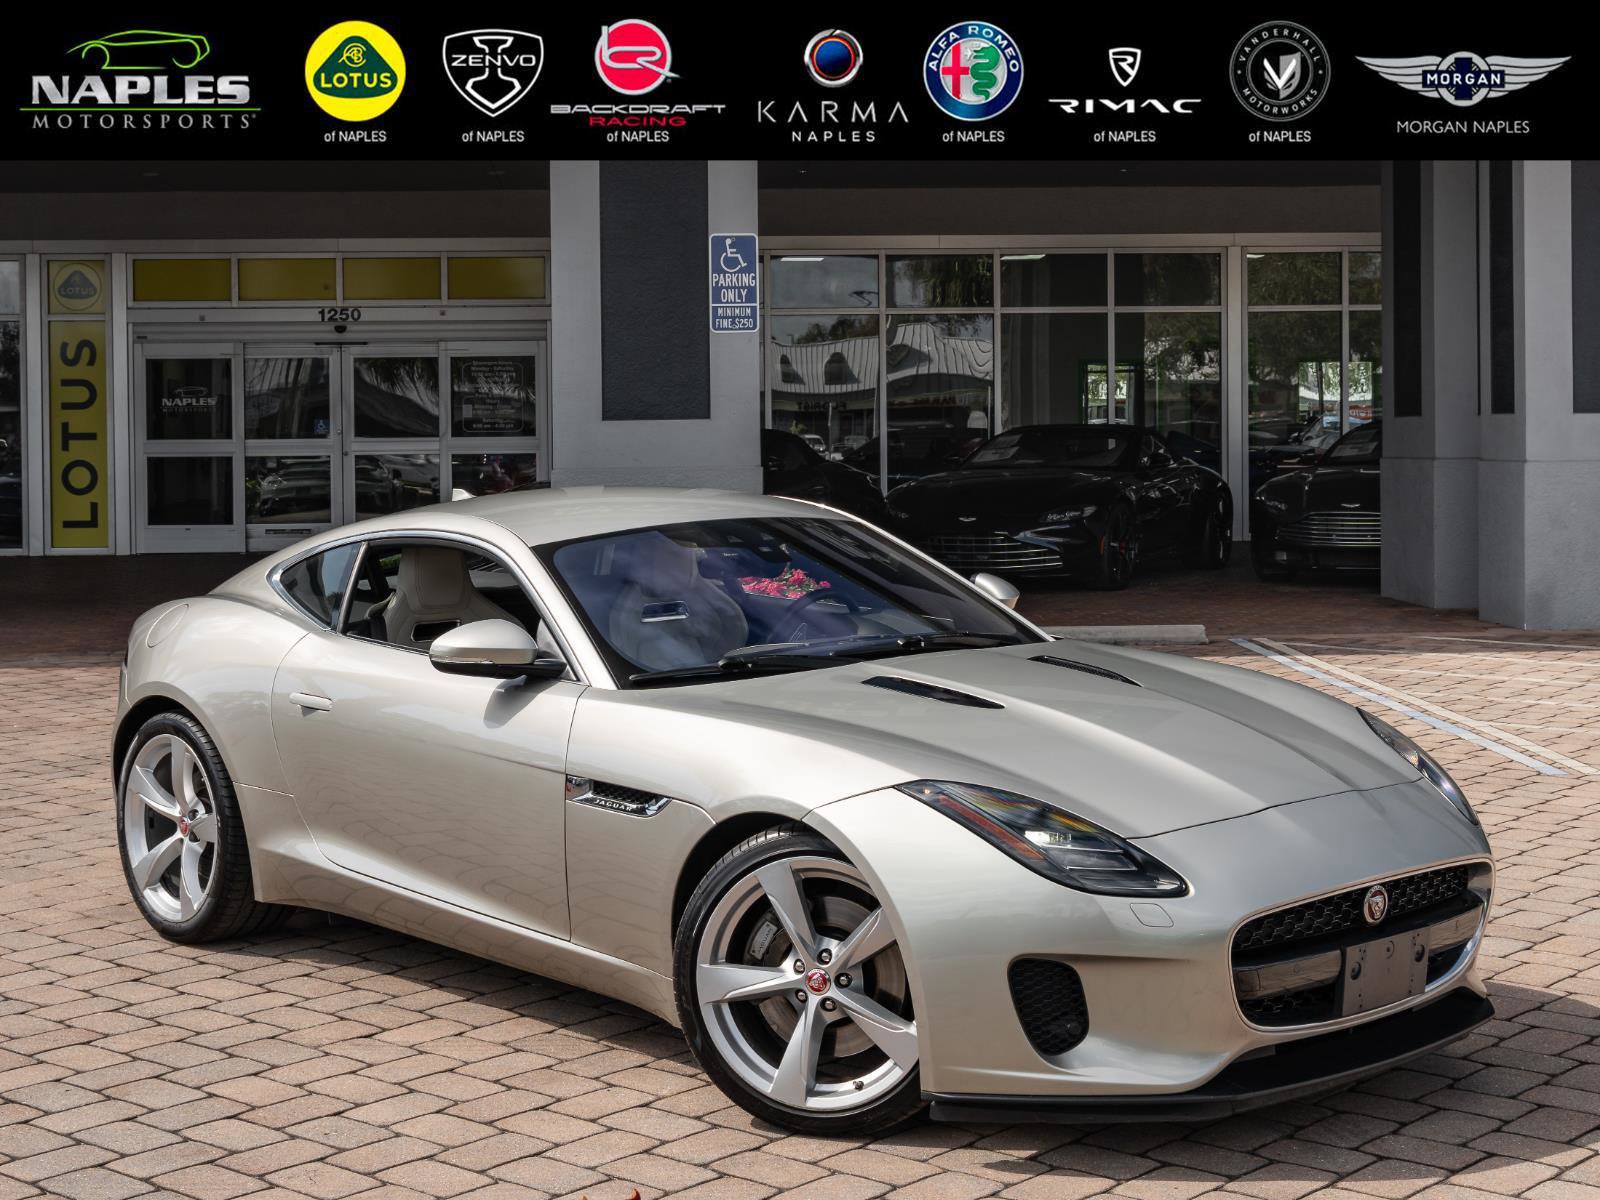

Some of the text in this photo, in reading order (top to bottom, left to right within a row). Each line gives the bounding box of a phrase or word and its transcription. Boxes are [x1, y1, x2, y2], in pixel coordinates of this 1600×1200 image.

[712, 273, 756, 287] PARKING
[720, 288, 748, 303] ONLY
[318, 308, 362, 322] 1250
[717, 307, 751, 317] MINIMUM
[715, 318, 754, 329] FINE $250
[161, 397, 217, 407] NAPLES
[61, 338, 99, 529] LOTUS
[594, 799, 633, 812] JAGUAR
